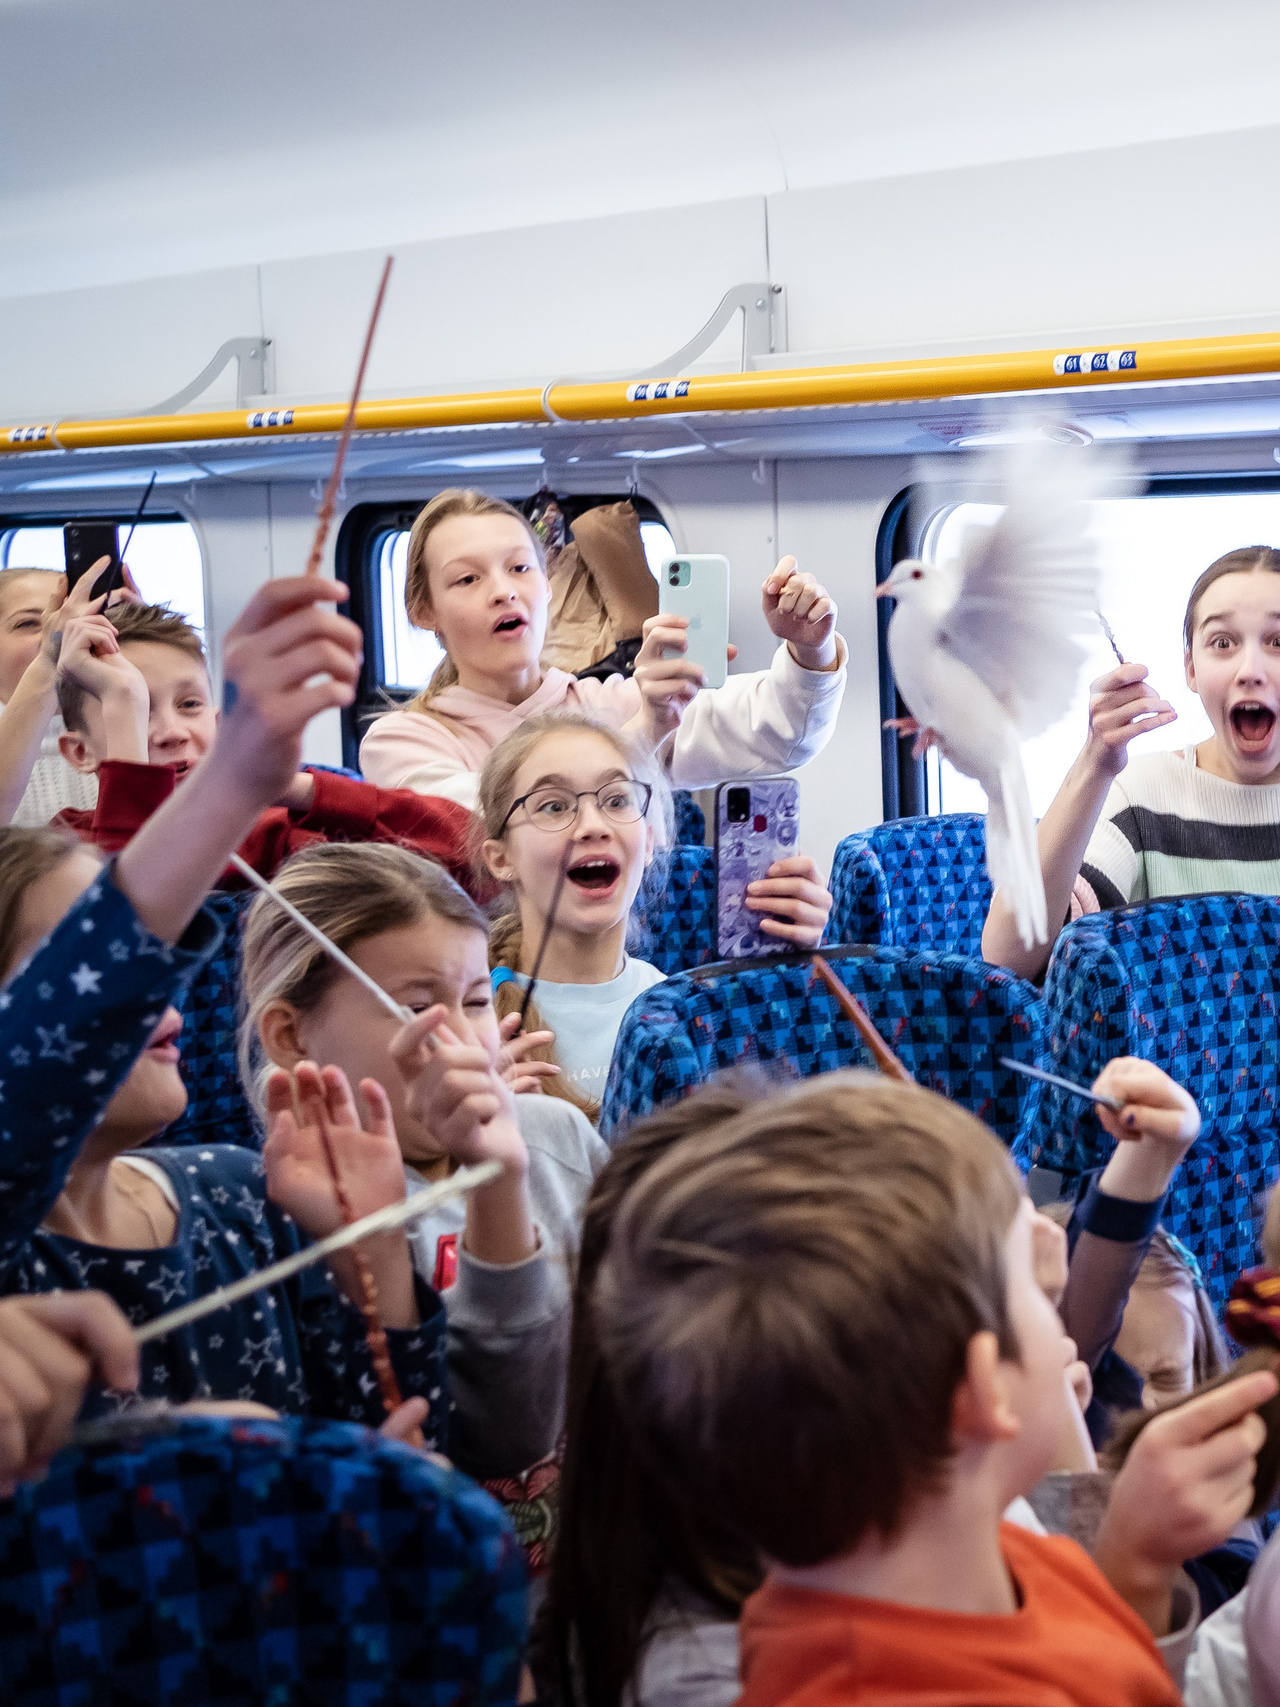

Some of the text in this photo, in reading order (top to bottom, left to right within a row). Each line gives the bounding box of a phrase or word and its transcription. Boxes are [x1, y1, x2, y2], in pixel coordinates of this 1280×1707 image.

[1065, 352, 1133, 371] 61 62 63
